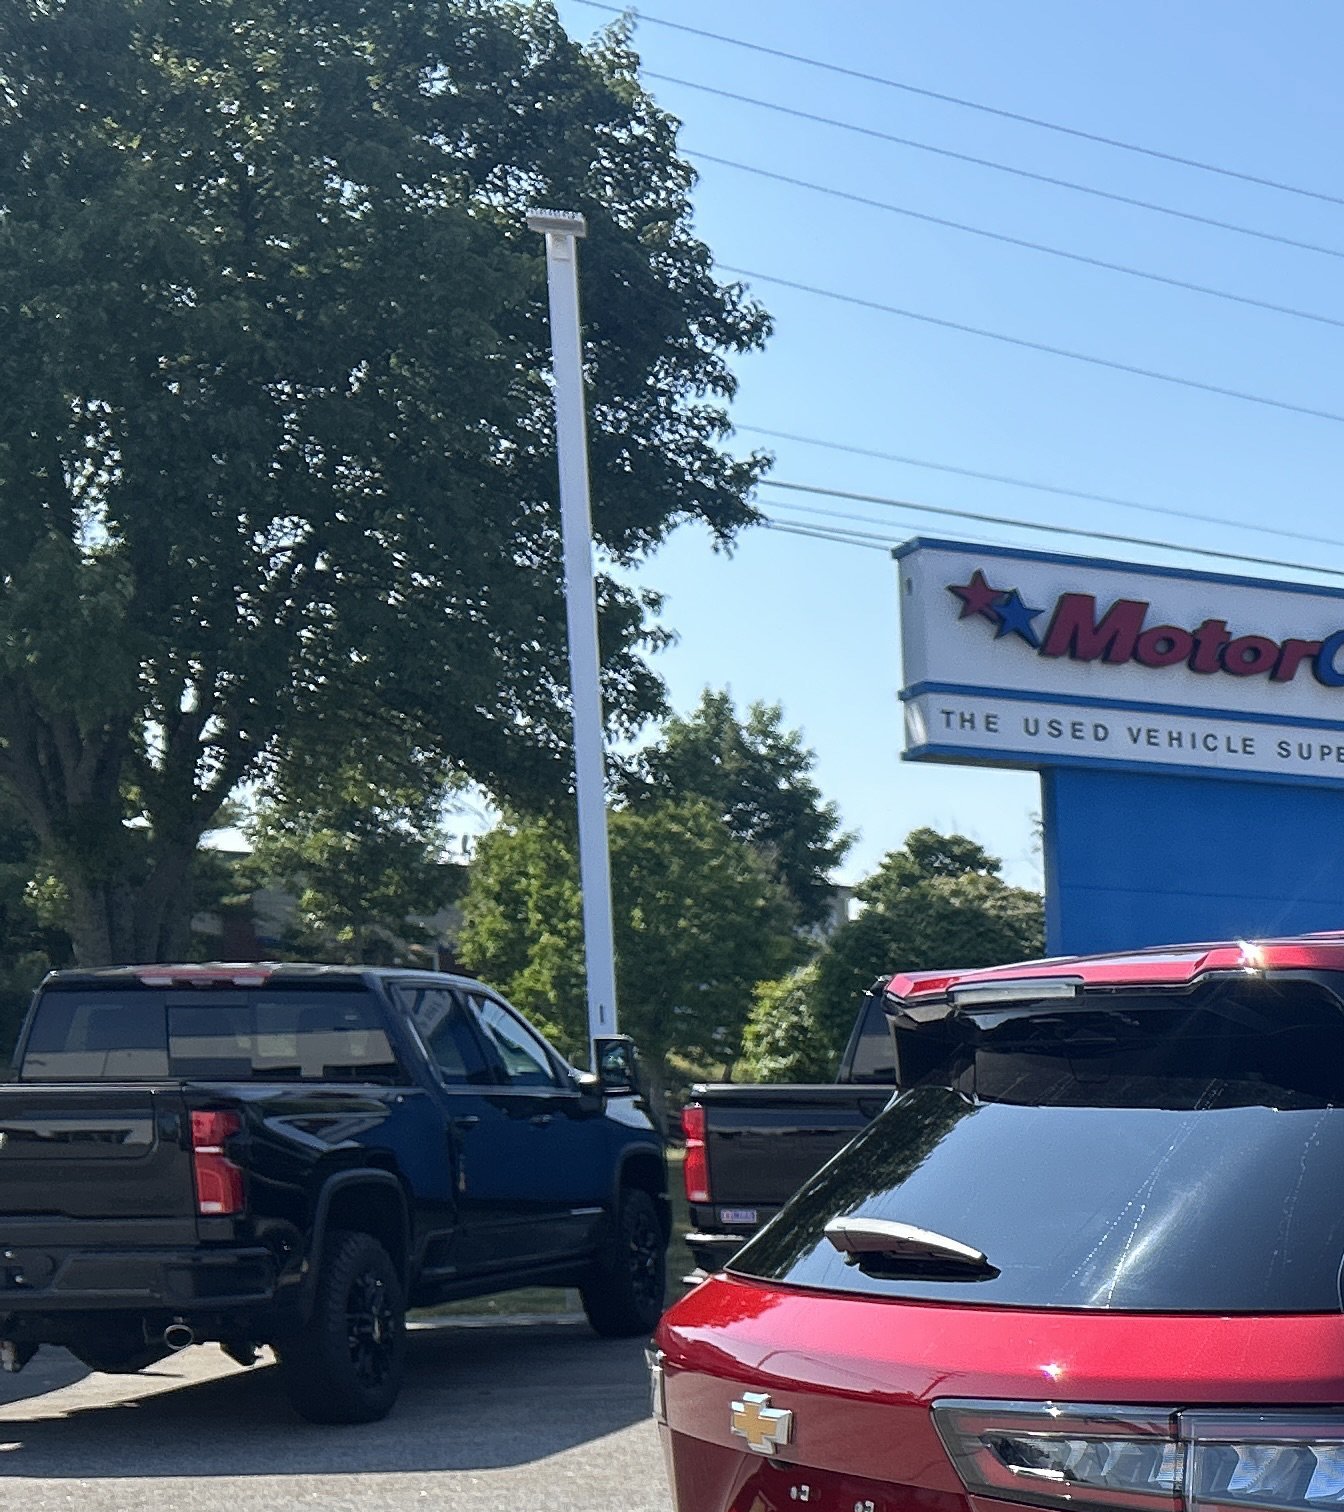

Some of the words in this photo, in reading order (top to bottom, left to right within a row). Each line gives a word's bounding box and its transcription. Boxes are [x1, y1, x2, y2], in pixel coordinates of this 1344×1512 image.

[941, 708, 1000, 735] THE
[1023, 716, 1109, 742] USED
[1127, 726, 1257, 757] VEHICLE
